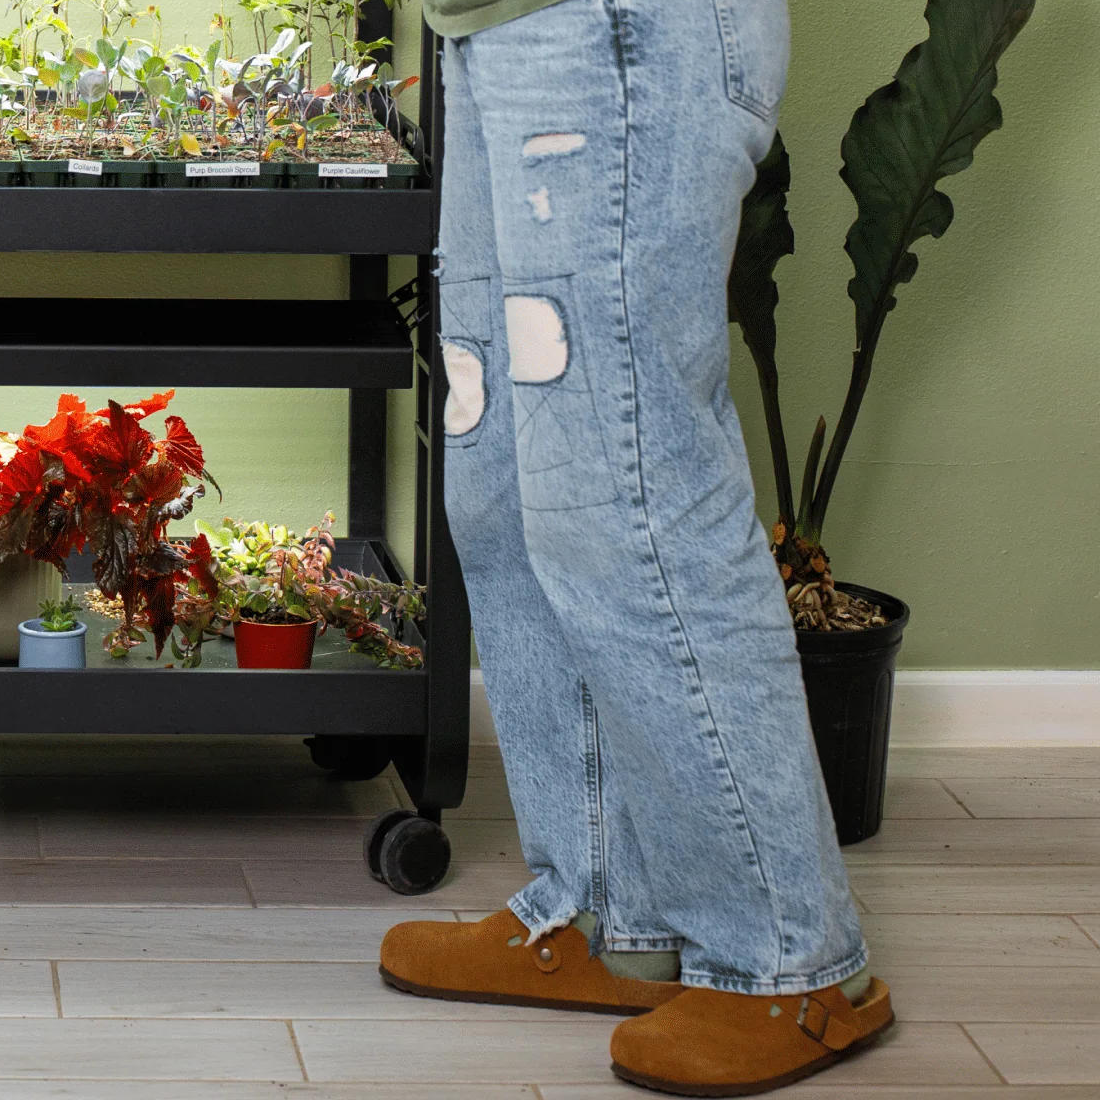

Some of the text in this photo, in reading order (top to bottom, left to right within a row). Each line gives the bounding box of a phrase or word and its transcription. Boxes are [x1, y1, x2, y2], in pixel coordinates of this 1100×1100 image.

[73, 162, 99, 172] Collards
[190, 166, 206, 174] Purp
[234, 166, 257, 174] Sprout
[322, 167, 344, 175] Purple
